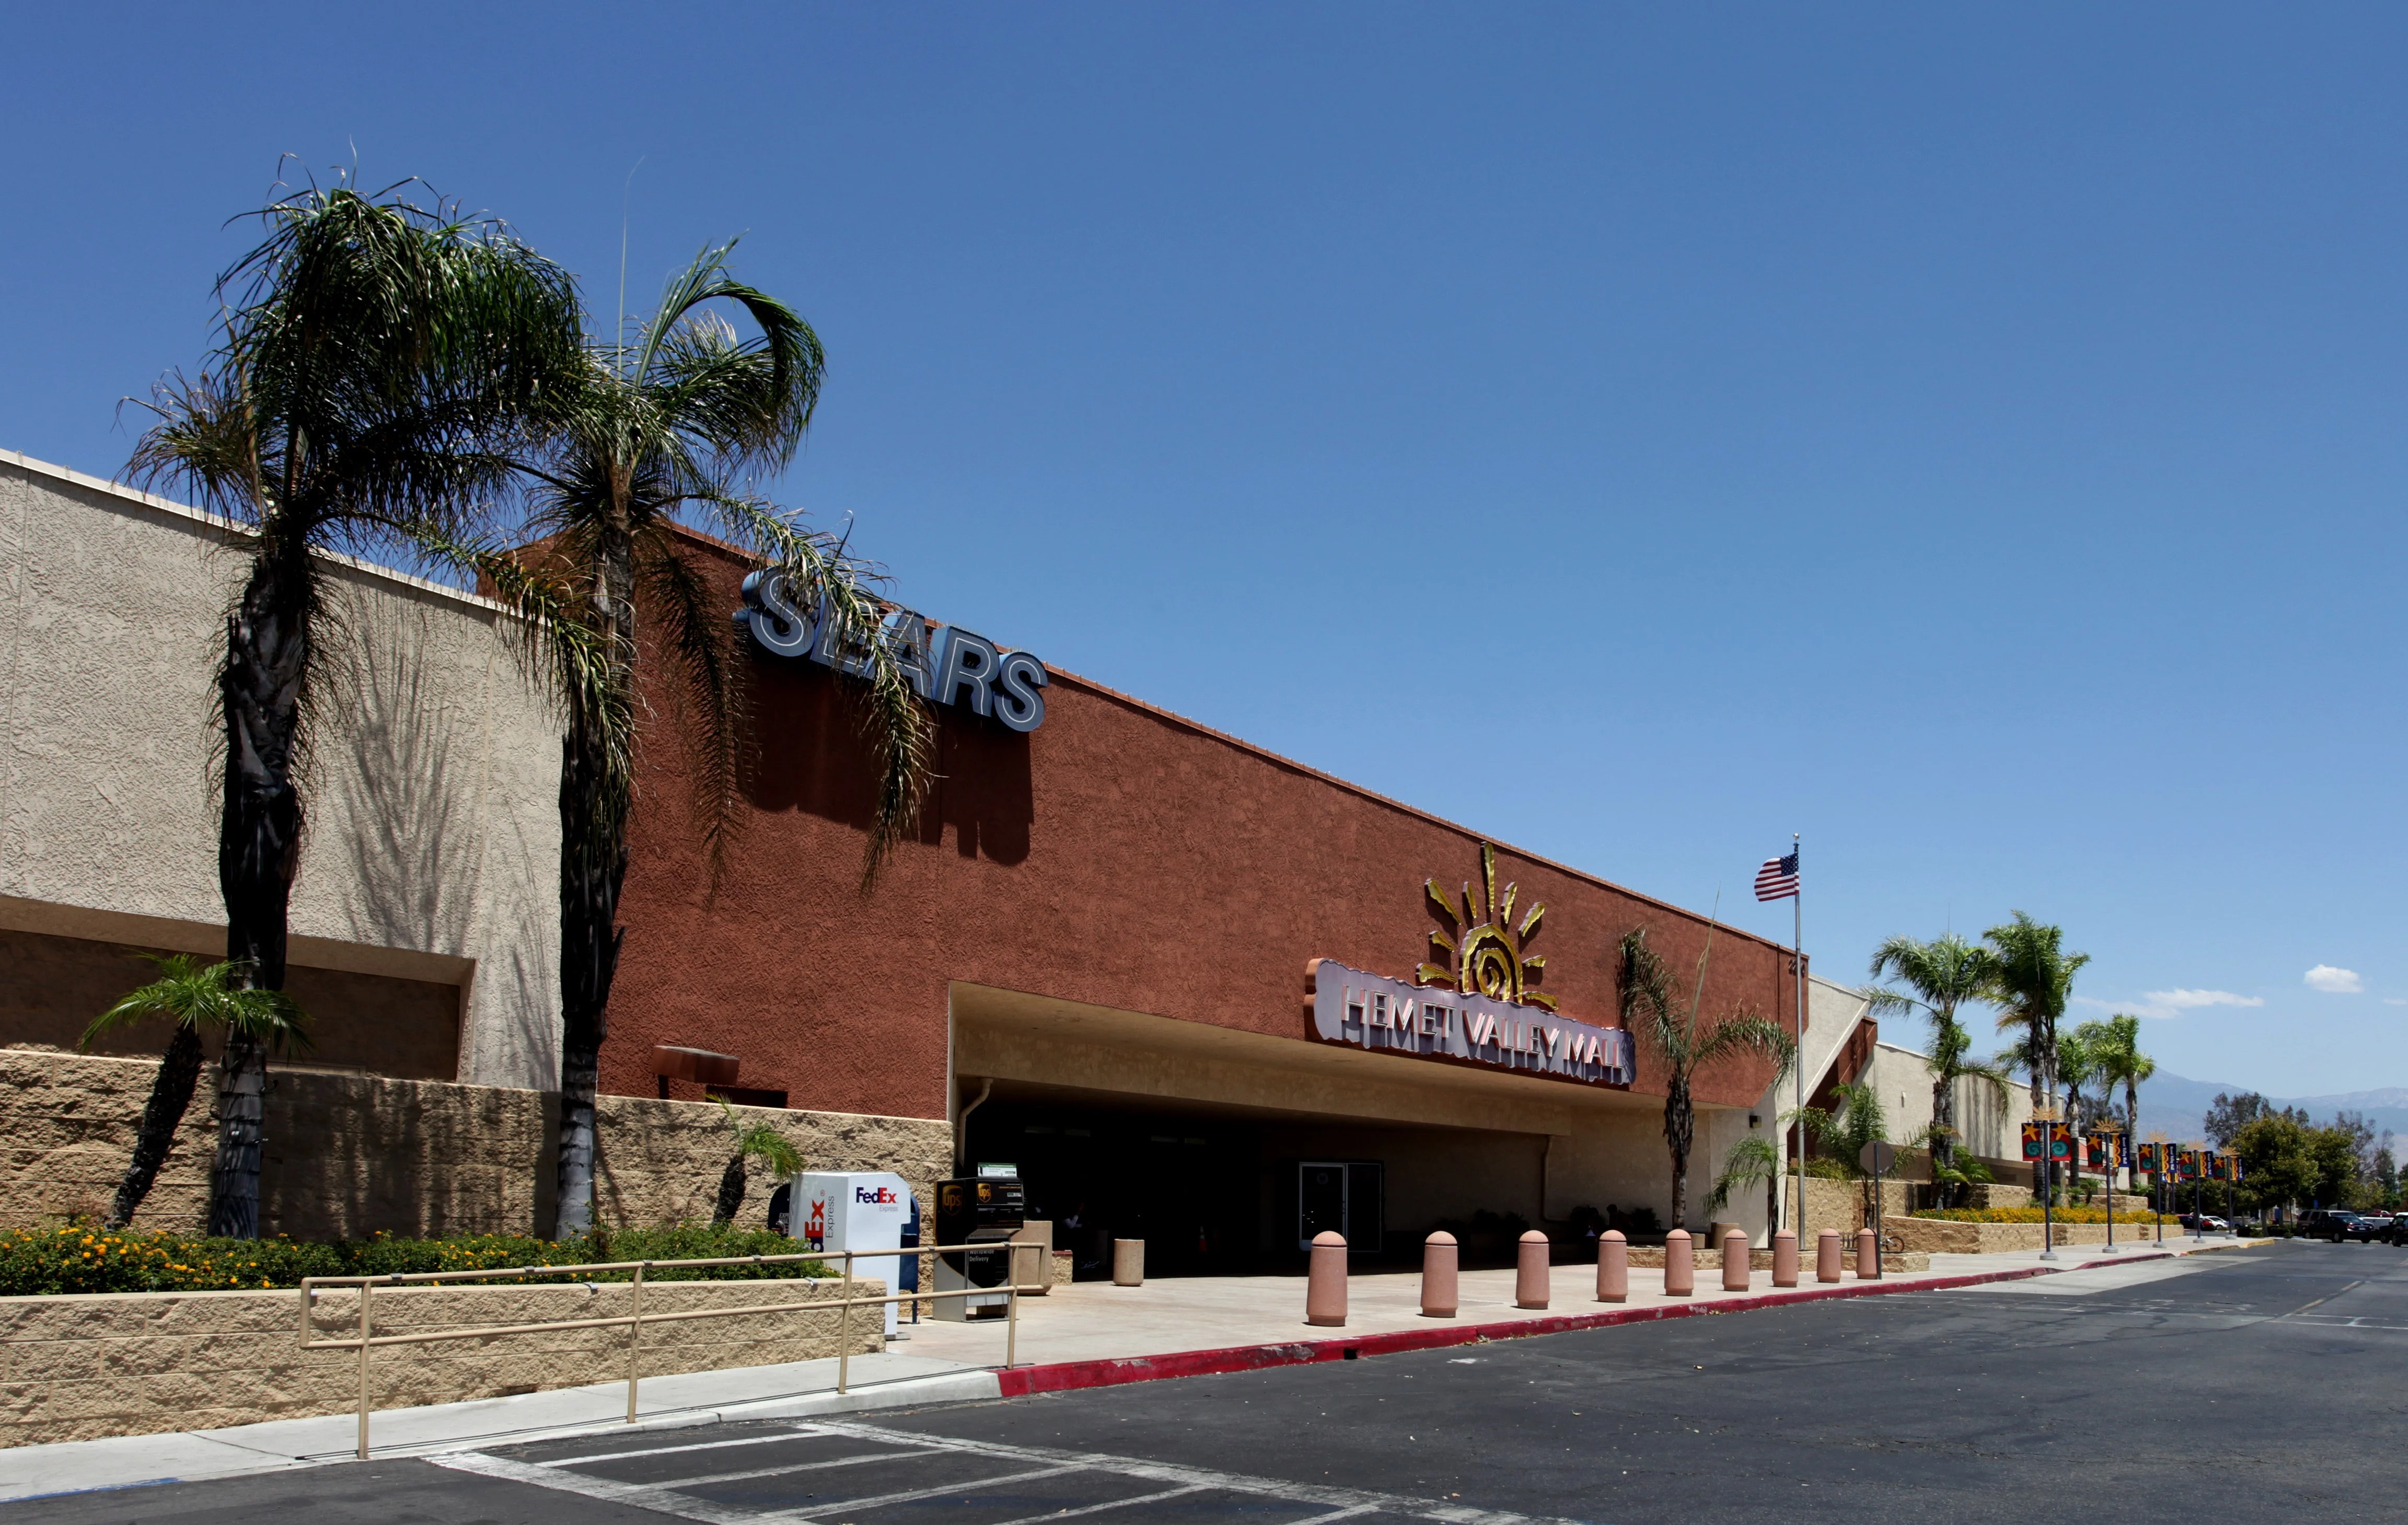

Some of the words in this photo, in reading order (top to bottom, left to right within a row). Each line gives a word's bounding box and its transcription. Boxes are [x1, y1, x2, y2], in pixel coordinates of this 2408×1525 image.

[734, 566, 1048, 732] SEARS
[1341, 985, 1456, 1038] HEMET
[1463, 1010, 1560, 1057] VALLEY
[1564, 1031, 1623, 1069] MALL
[856, 1187, 897, 1204] FedEx
[944, 1194, 961, 1210] ups
[979, 1188, 991, 1199] ups
[805, 1199, 824, 1253] dEx
[826, 1196, 835, 1238] Express
